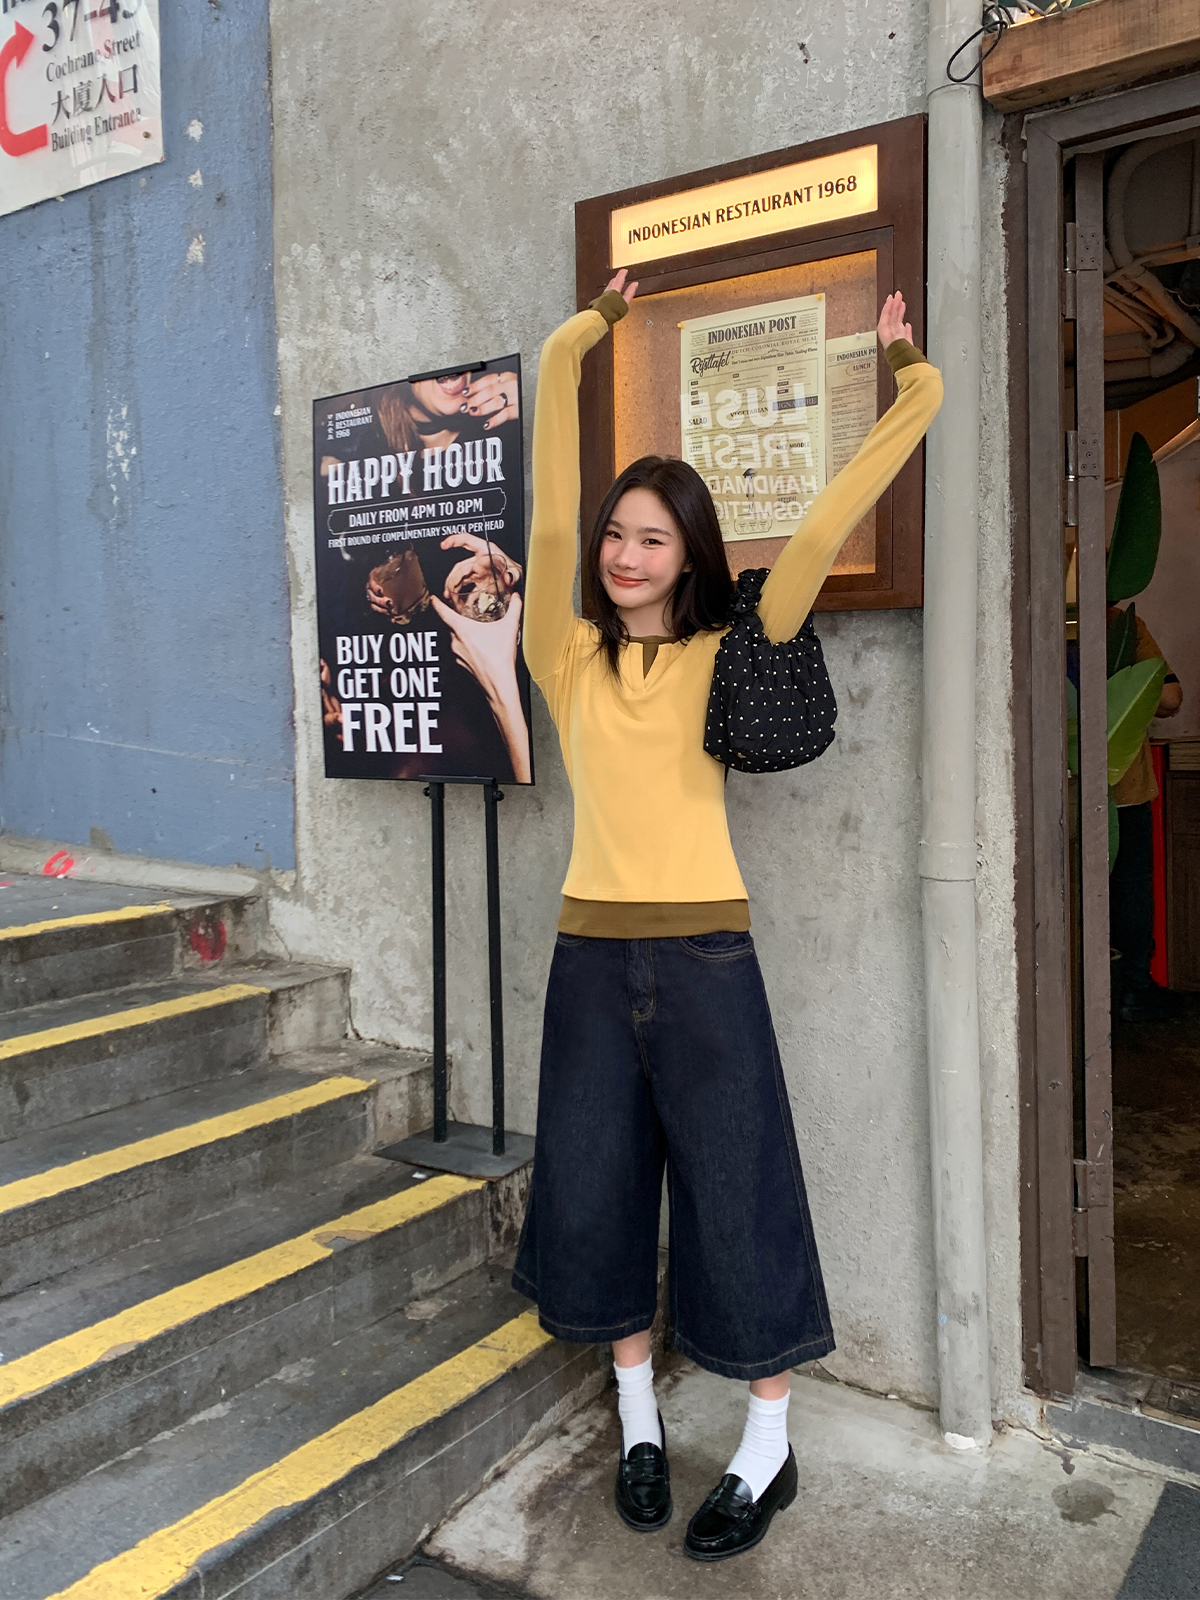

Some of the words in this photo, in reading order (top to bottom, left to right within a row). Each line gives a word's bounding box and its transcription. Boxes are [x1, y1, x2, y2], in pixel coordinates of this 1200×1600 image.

[46, 49, 100, 82] Cochrane
[103, 29, 141, 60] Street
[51, 63, 139, 126] 大廈入口
[51, 121, 93, 153] Building
[94, 106, 141, 137] Entrance
[628, 210, 711, 245] INDONESIAN
[716, 186, 813, 224] RESTAURANT
[817, 175, 858, 199] 1968
[707, 320, 766, 345] INDONESIAN
[768, 315, 797, 333] POST
[836, 349, 868, 362] INDONESIAN
[853, 362, 871, 371] LUNCH
[335, 406, 371, 421] INDONESIAN
[774, 397, 817, 411] SIGNATURE
[335, 414, 373, 430] RESTAURANT
[336, 428, 351, 439] 1968
[688, 417, 708, 427] SALAD
[328, 450, 417, 505] HAPPY
[423, 436, 506, 492] HOUR
[348, 510, 377, 528] DAILY
[379, 506, 409, 524] FROM
[410, 503, 436, 519] 4PM
[438, 501, 454, 516] TO
[456, 497, 483, 514] 8PM
[328, 537, 346, 549] FIRST
[347, 535, 371, 546] ROUND
[372, 534, 381, 544] OF
[381, 526, 440, 543] COMPLIMENTARY
[441, 523, 467, 536] SNACK
[468, 521, 484, 533] PER
[484, 519, 505, 531] HEAD
[335, 633, 384, 665] BUY
[389, 631, 440, 663] ONE
[337, 668, 383, 699] GET
[390, 666, 442, 699] ONE
[340, 701, 443, 754] FREE
